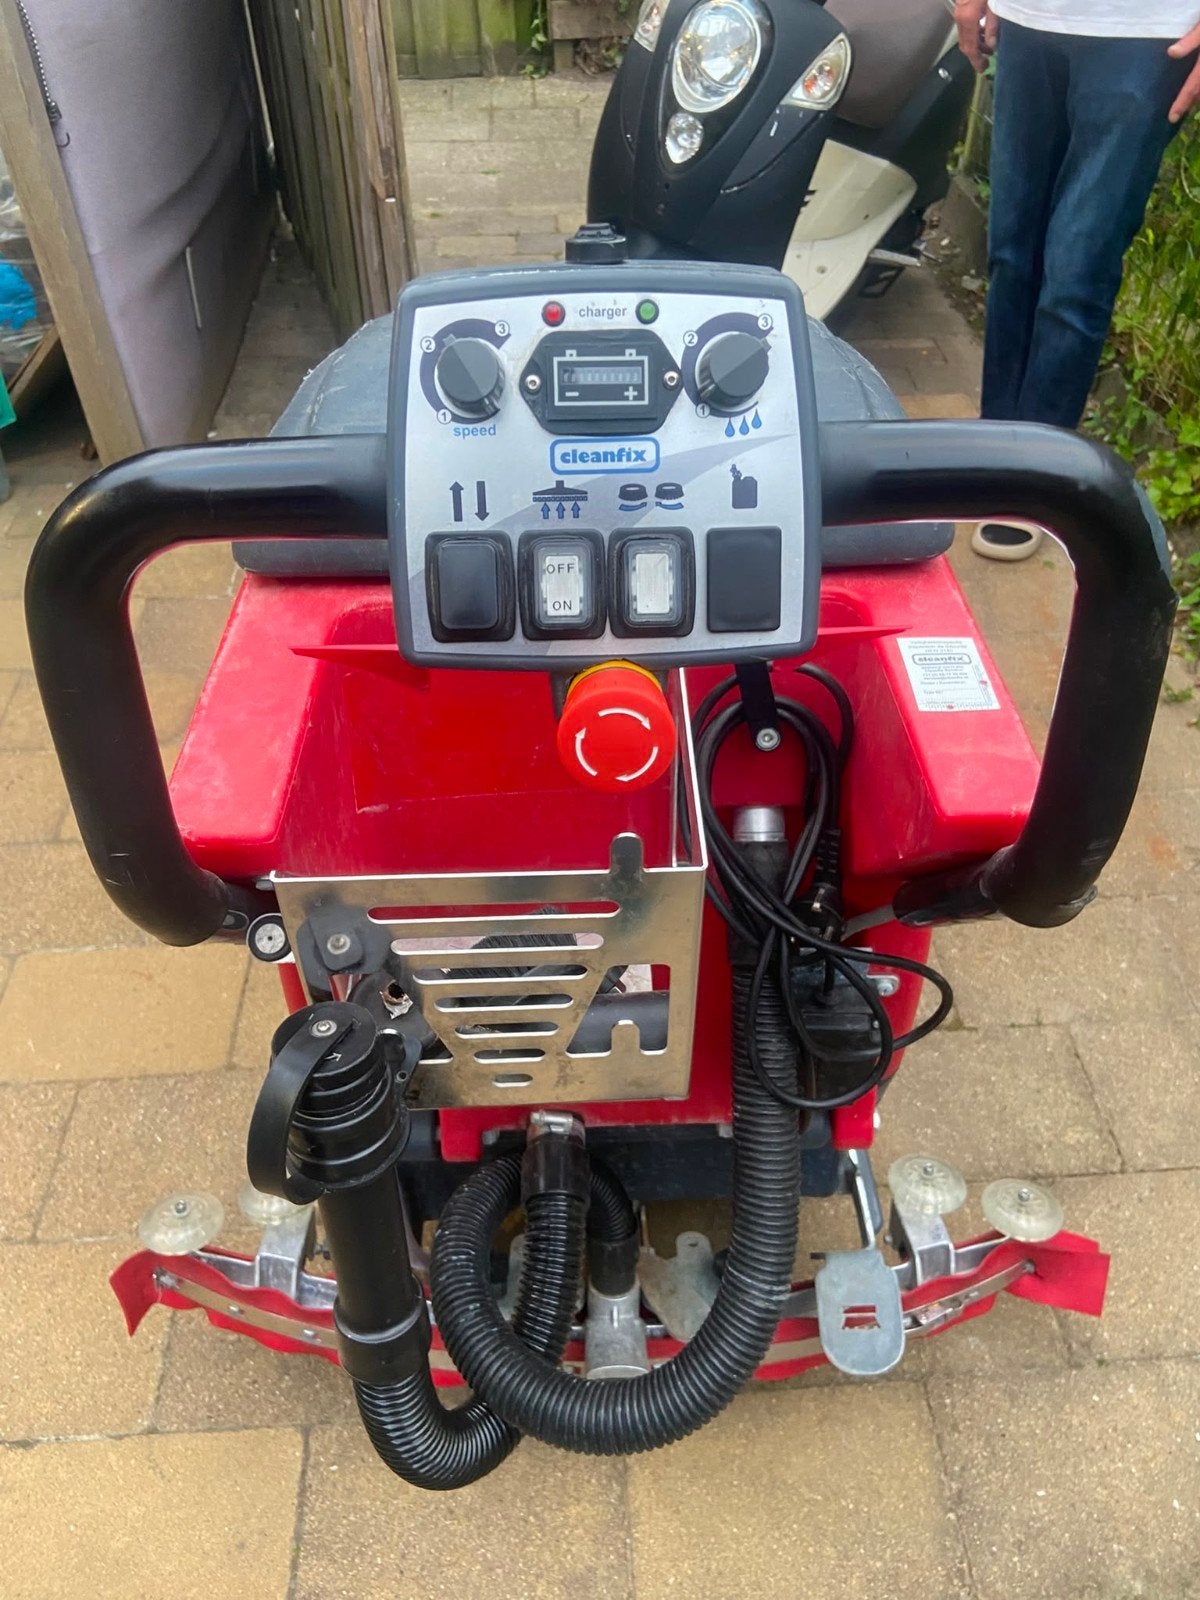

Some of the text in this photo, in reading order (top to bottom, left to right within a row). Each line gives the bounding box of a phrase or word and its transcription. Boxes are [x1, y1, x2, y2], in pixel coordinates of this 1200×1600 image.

[578, 305, 627, 319] charger
[761, 317, 769, 328] 3
[498, 323, 506, 335] 3
[425, 338, 433, 350] 2
[687, 333, 696, 345] 2
[453, 424, 497, 440] speed
[560, 447, 648, 465] cleanfix
[546, 563, 575, 574] OFF
[552, 600, 572, 611] ON
